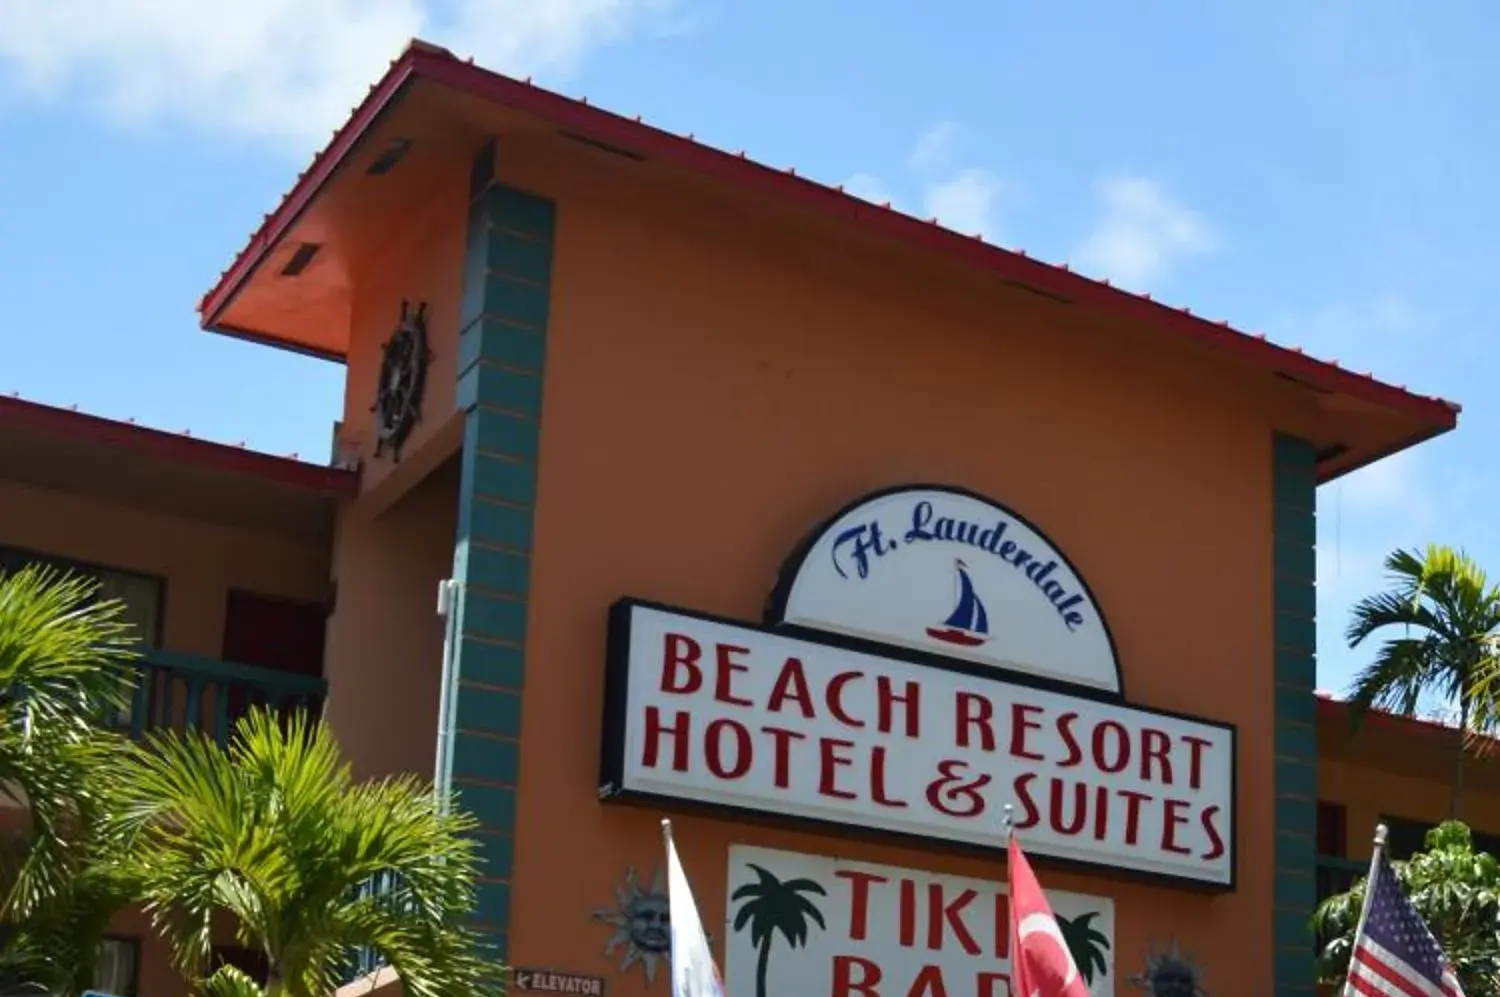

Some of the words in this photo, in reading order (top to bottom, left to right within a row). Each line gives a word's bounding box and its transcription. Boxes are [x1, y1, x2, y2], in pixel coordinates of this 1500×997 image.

[831, 518, 898, 579] Ft.
[904, 501, 1085, 633] Lauderdale
[659, 633, 922, 739] BEACH
[954, 690, 1214, 789] RESORT
[641, 705, 908, 808] HOTEL
[926, 760, 992, 818] &
[1011, 772, 1226, 861] SUITES
[834, 870, 1010, 960] TIKI
[532, 973, 602, 996] ELEVATOR
